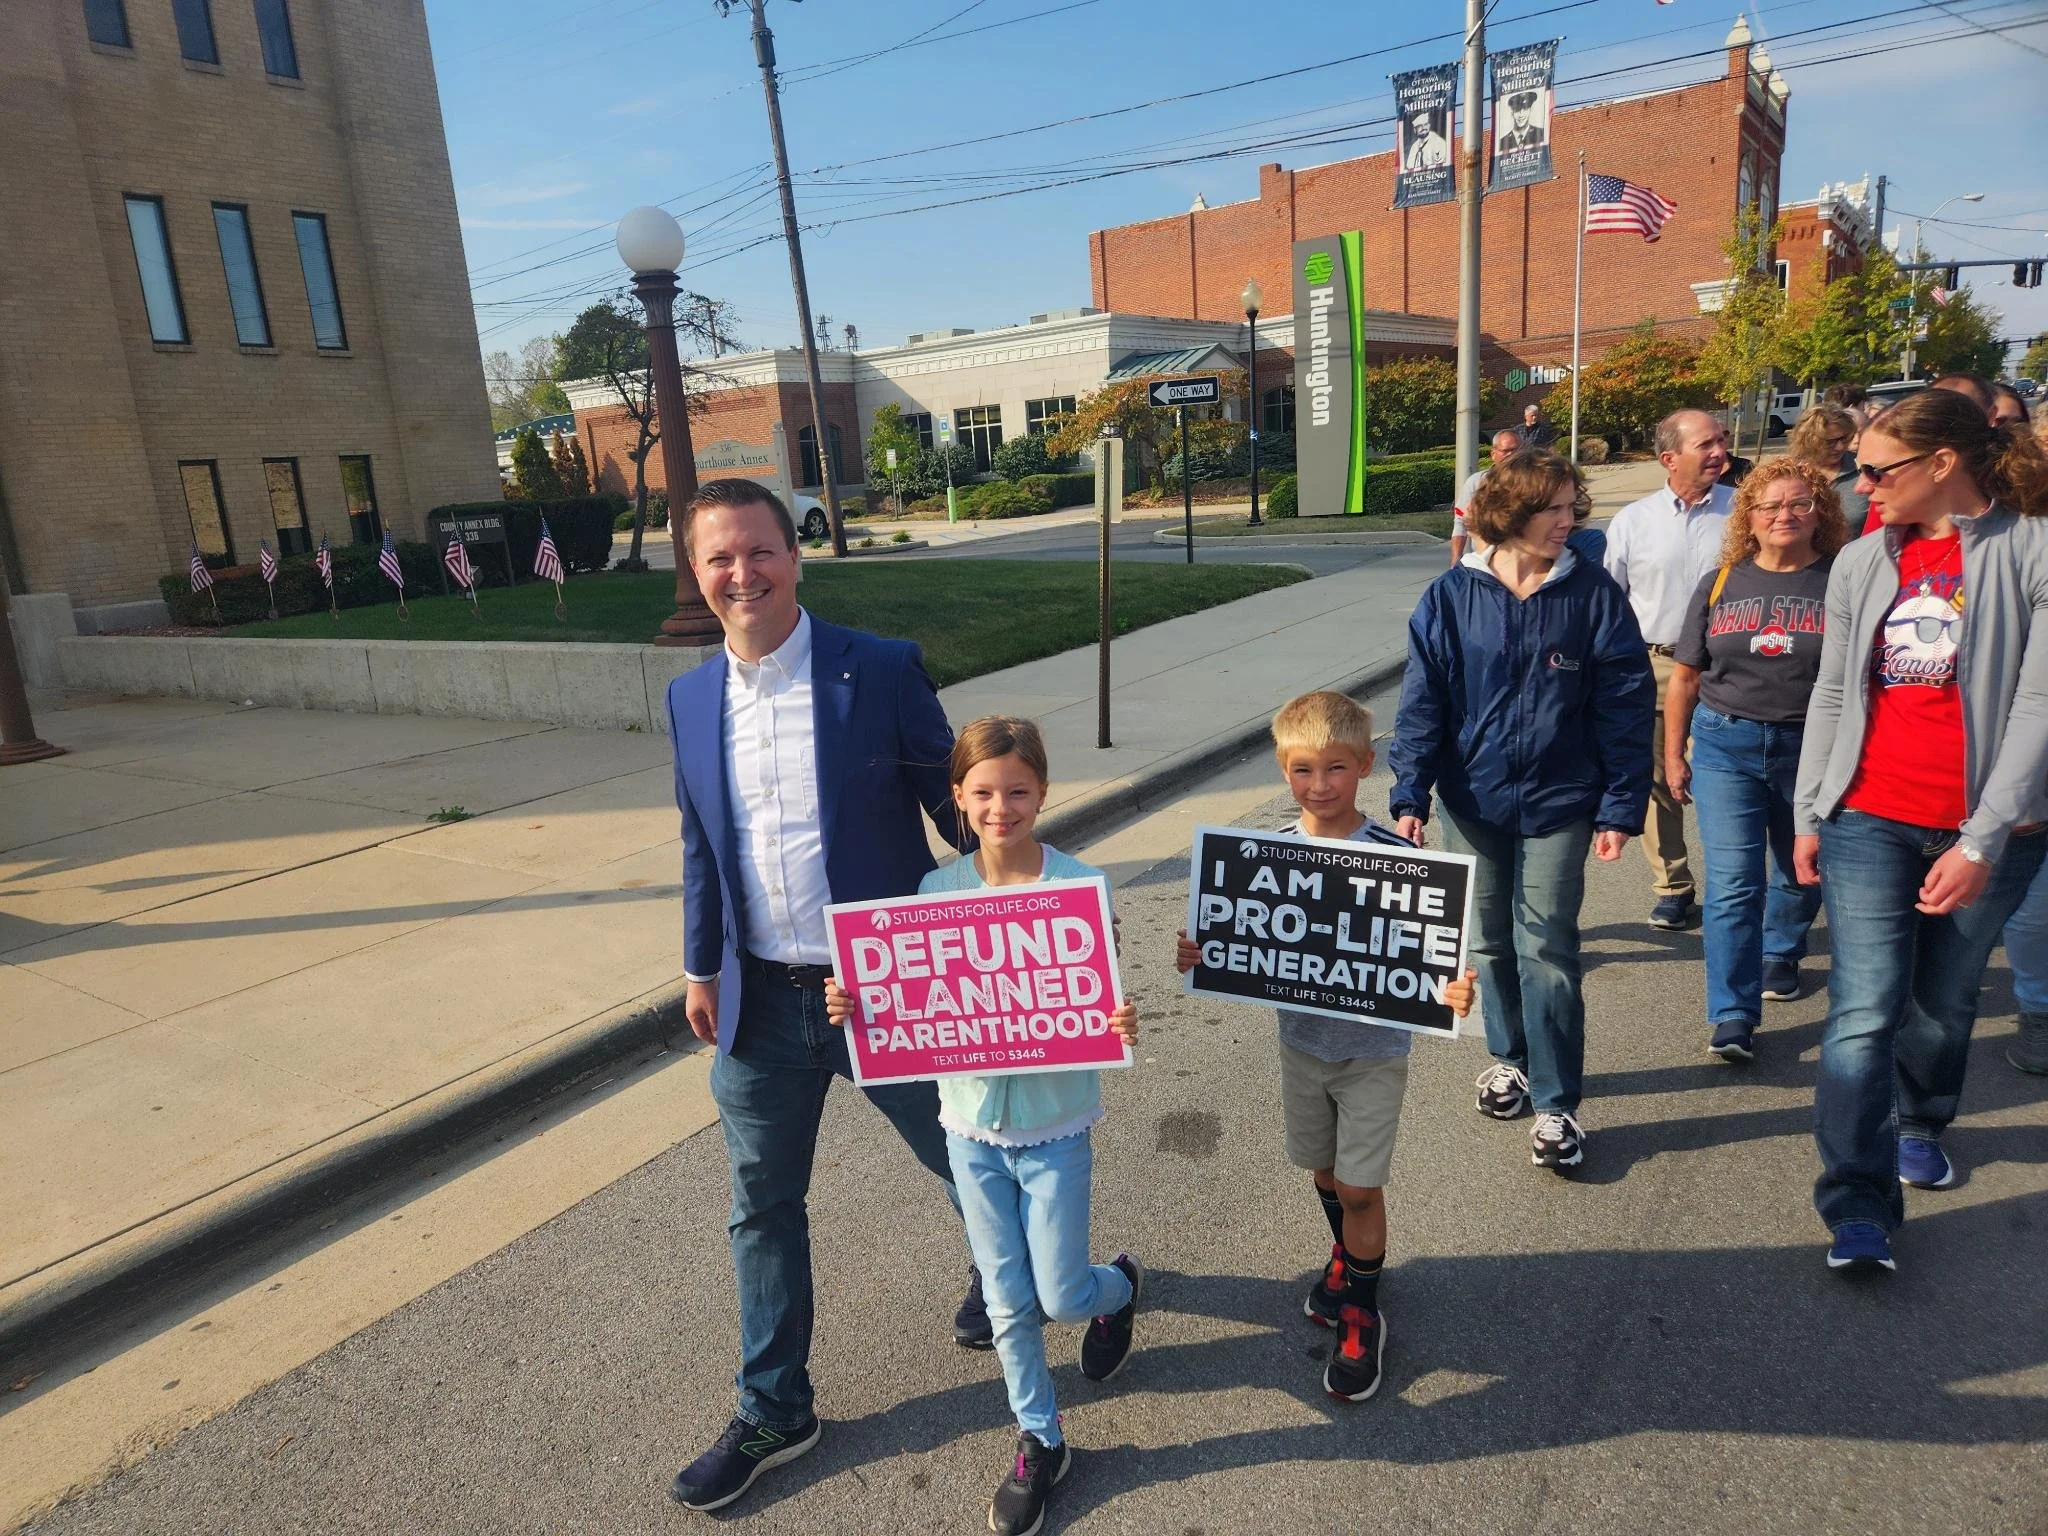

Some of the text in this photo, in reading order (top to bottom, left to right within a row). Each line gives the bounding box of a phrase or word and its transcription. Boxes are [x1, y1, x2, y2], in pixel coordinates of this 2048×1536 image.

[1496, 59, 1551, 79] Honoring
[1510, 54, 1538, 66] OTTAWA
[1411, 75, 1439, 87] OTTAWA
[1501, 75, 1545, 93] Military
[1516, 72, 1529, 80] our
[1399, 80, 1452, 99] Honoring
[1404, 97, 1446, 113] Military
[1500, 151, 1542, 167] BECKETT
[1403, 171, 1447, 185] KLAUSING
[1305, 286, 1334, 426] Huntington
[1169, 384, 1211, 398] ONE WAY
[719, 443, 732, 453] 336
[695, 454, 769, 470] ourthouse Annex
[439, 521, 464, 533] COUNTY
[464, 519, 484, 530] ANNEX
[1710, 595, 1826, 638] OHIO STAT
[1879, 643, 1952, 683] Kenos
[1260, 845, 1429, 878] STUDENTSFORLIFE.ORG
[1214, 860, 1447, 918] I AM THE
[892, 896, 1061, 925] STUDENTSFORLIFE.ORG
[1198, 893, 1460, 968] PRO-LIFE
[850, 916, 1096, 984] DEFUND
[1201, 939, 1449, 1006] GENERATION
[859, 966, 1103, 1024] PLANNED
[1264, 983, 1376, 1010] TEXT LIFE TO 53445
[866, 1009, 1108, 1054] PARENTHOOD
[932, 1047, 1046, 1067] TEXT LIFE TO 53445
